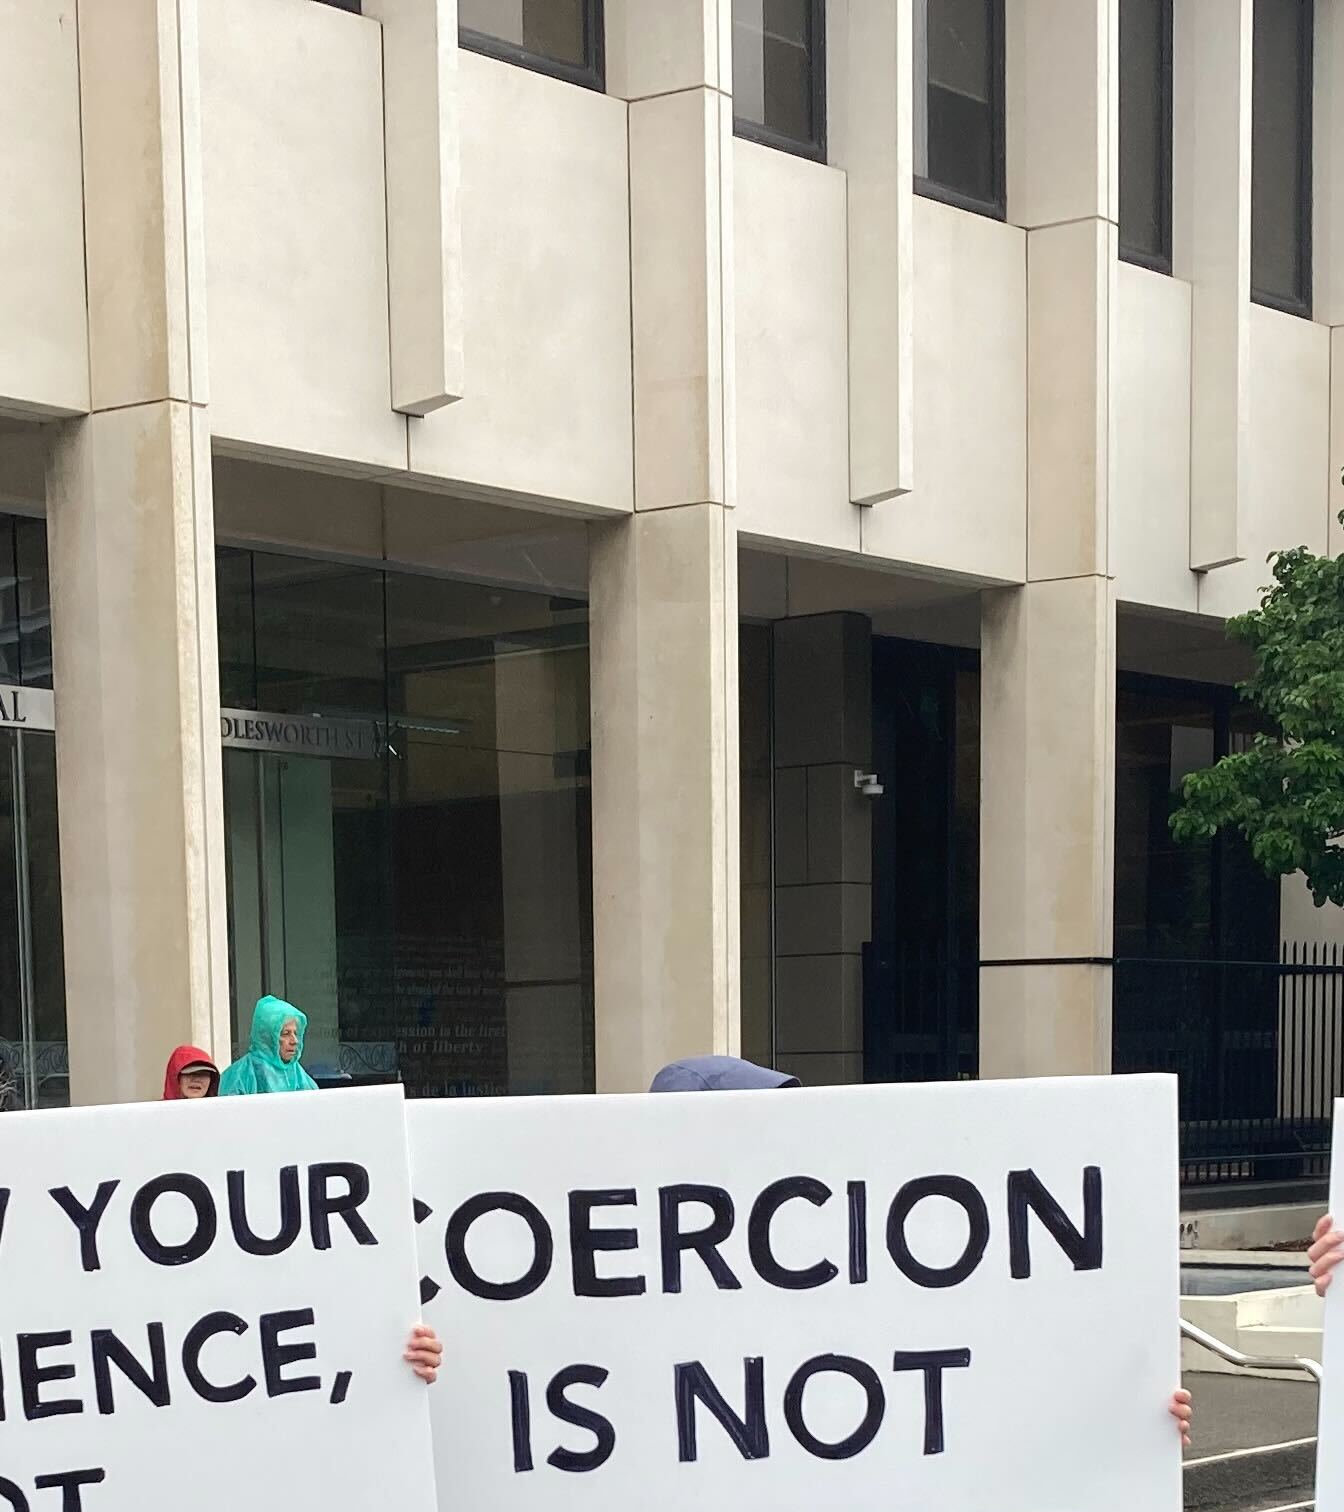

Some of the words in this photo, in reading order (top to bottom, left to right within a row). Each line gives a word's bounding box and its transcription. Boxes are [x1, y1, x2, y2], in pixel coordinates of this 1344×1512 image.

[48, 1162, 378, 1272] YOUR
[508, 1364, 615, 1472] IS
[675, 1348, 970, 1462] NOT
